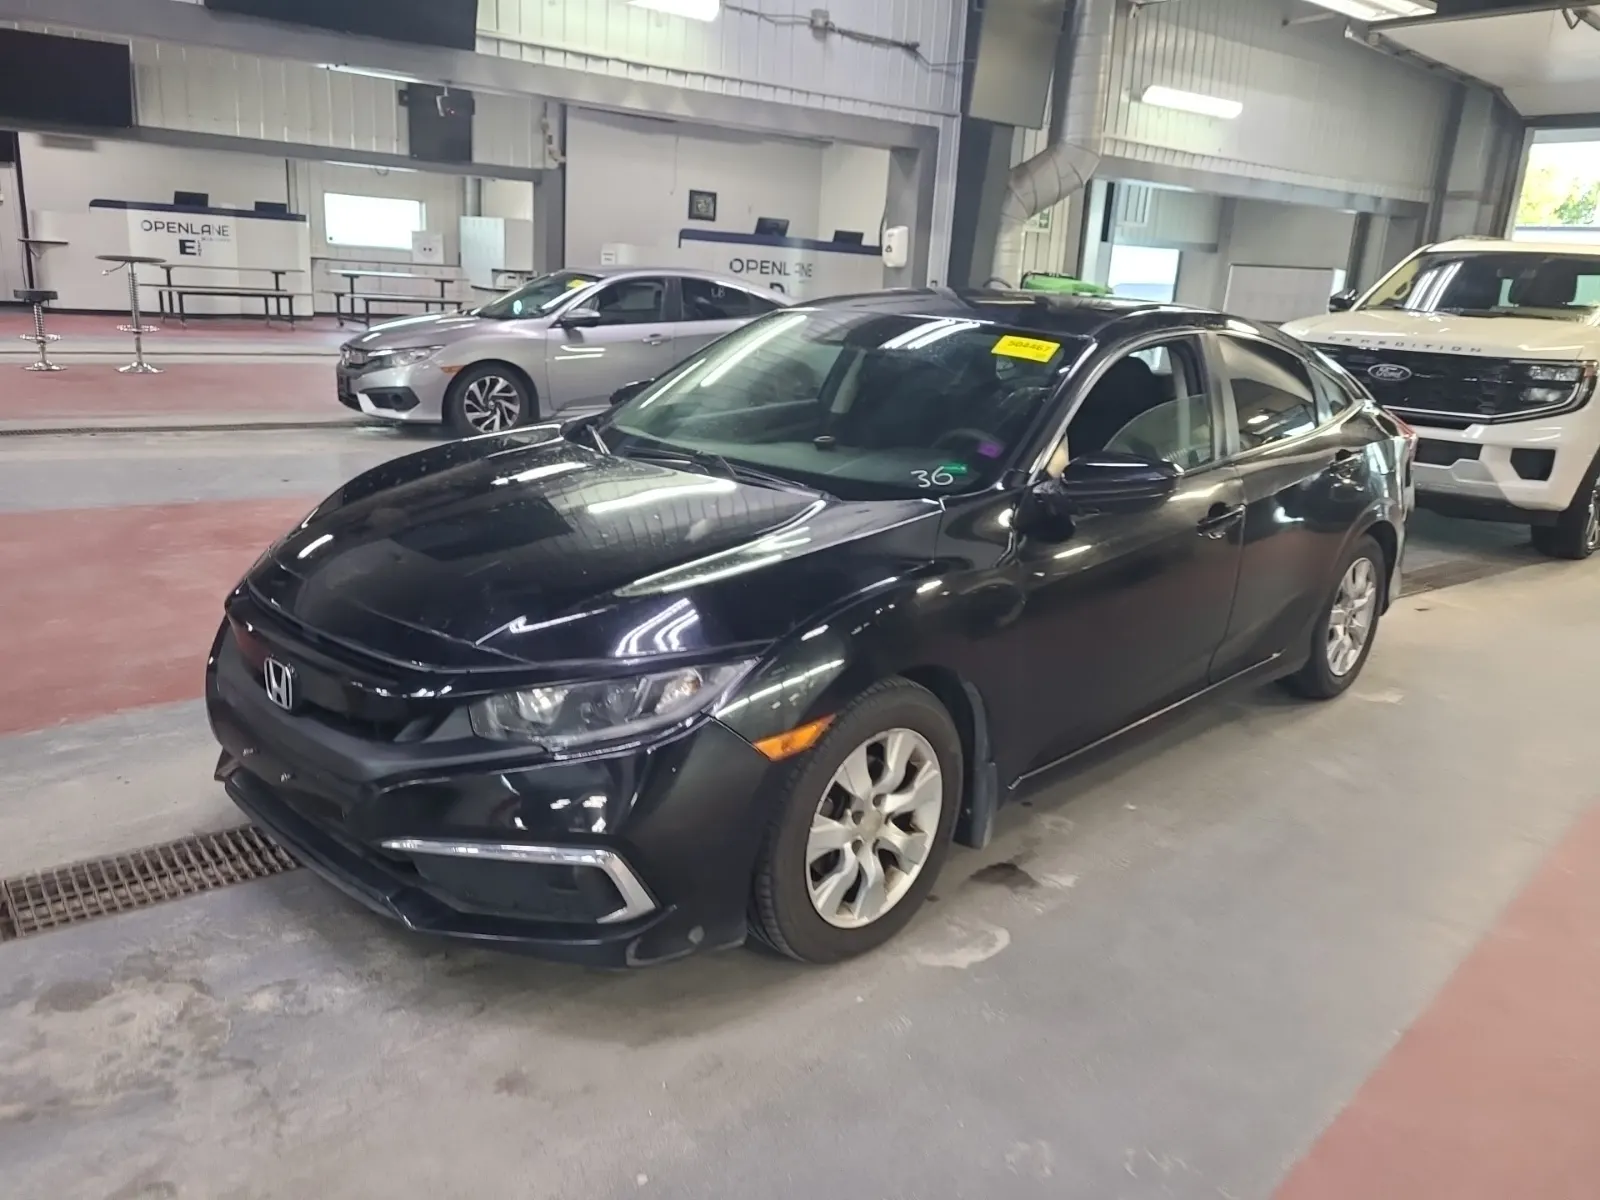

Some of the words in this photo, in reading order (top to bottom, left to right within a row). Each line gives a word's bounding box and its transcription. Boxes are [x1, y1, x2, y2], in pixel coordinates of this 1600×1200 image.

[141, 219, 230, 237] OPENLANE
[179, 239, 197, 256] E
[1327, 336, 1482, 352] EXPEDITION
[1375, 366, 1403, 379] Ford
[910, 466, 954, 488] 36
